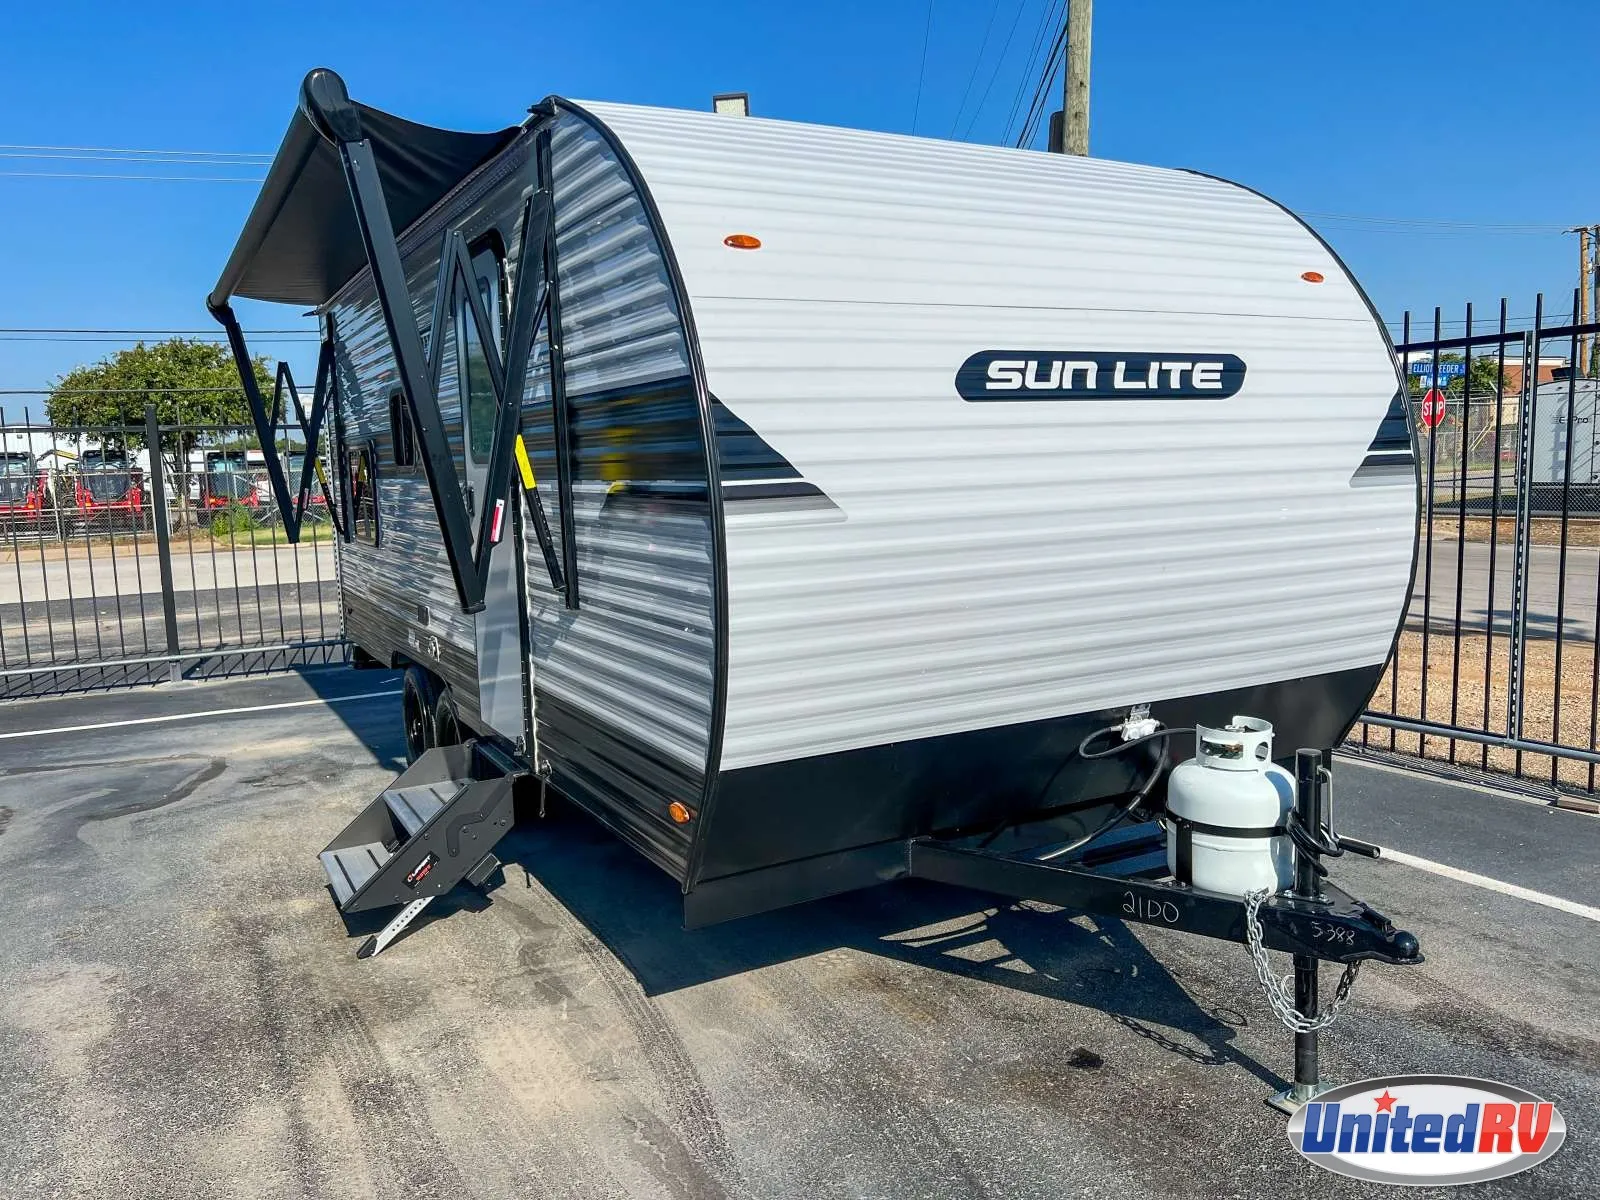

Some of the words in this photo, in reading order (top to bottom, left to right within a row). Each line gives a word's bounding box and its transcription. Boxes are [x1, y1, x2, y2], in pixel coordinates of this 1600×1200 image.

[986, 360, 1098, 389] SUN
[1114, 361, 1223, 389] LITE
[1424, 401, 1443, 416] STP
